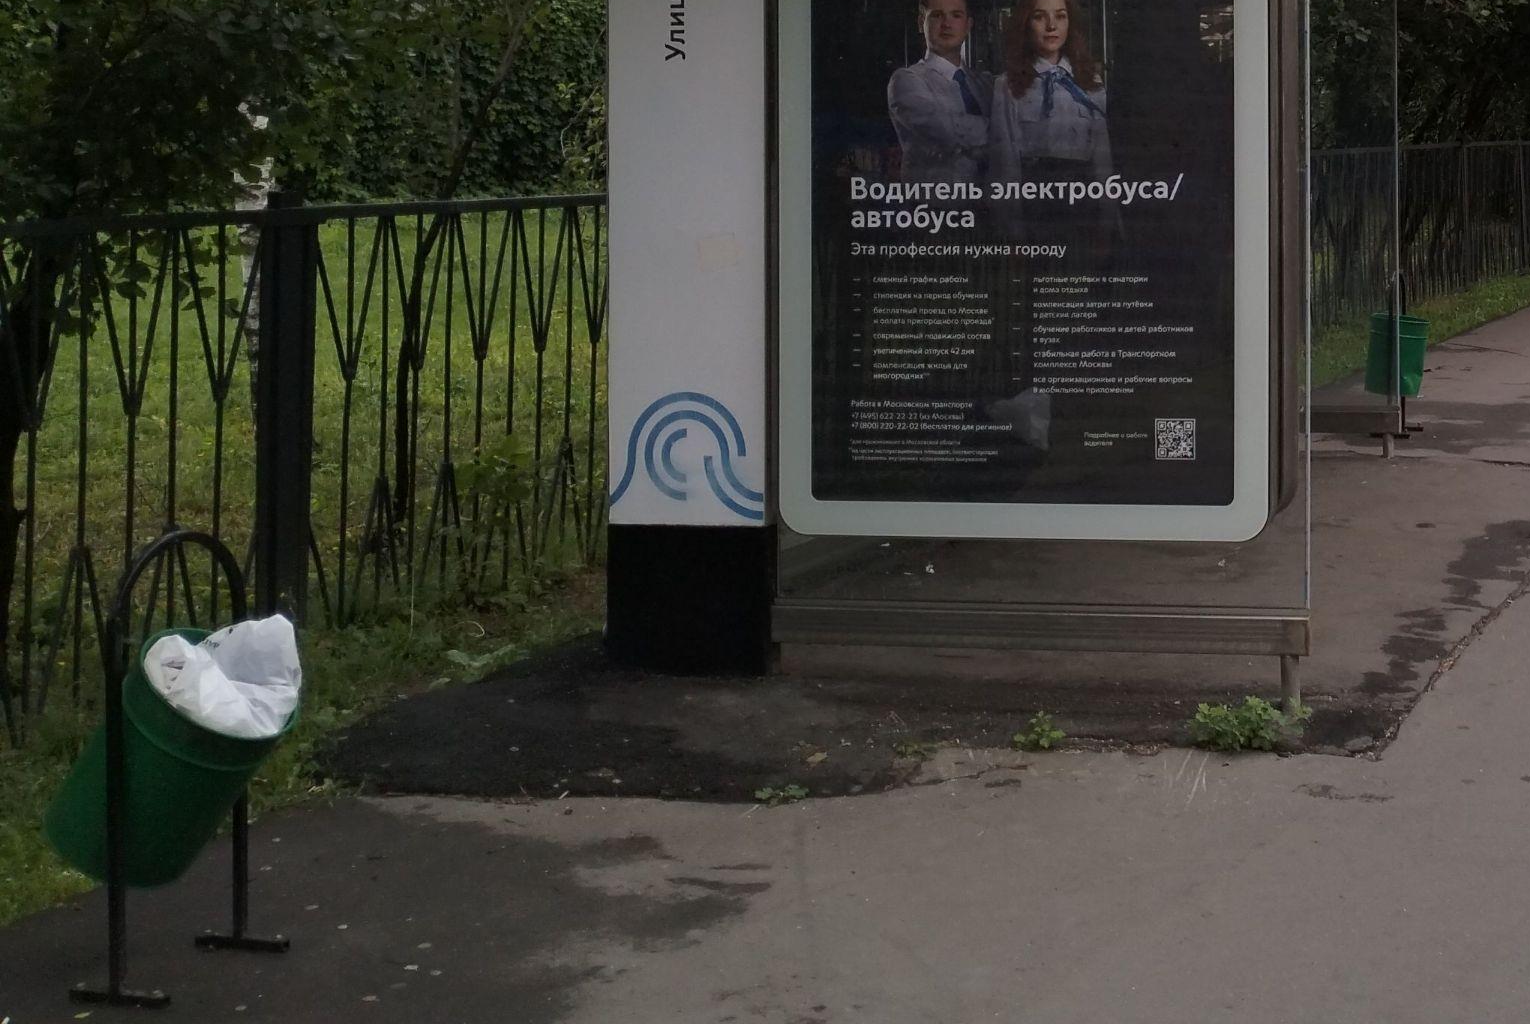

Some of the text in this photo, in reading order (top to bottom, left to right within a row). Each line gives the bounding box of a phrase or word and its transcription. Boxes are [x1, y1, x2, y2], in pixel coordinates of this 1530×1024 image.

[851, 173, 1184, 205] Водитель электробуса/
[851, 204, 975, 233] автобуса
[851, 242, 1066, 259] Эта профессия нужна городу
[939, 276, 969, 284] работы
[1124, 325, 1147, 333] детей
[1081, 350, 1109, 359] работа
[1034, 361, 1077, 369] комплексе
